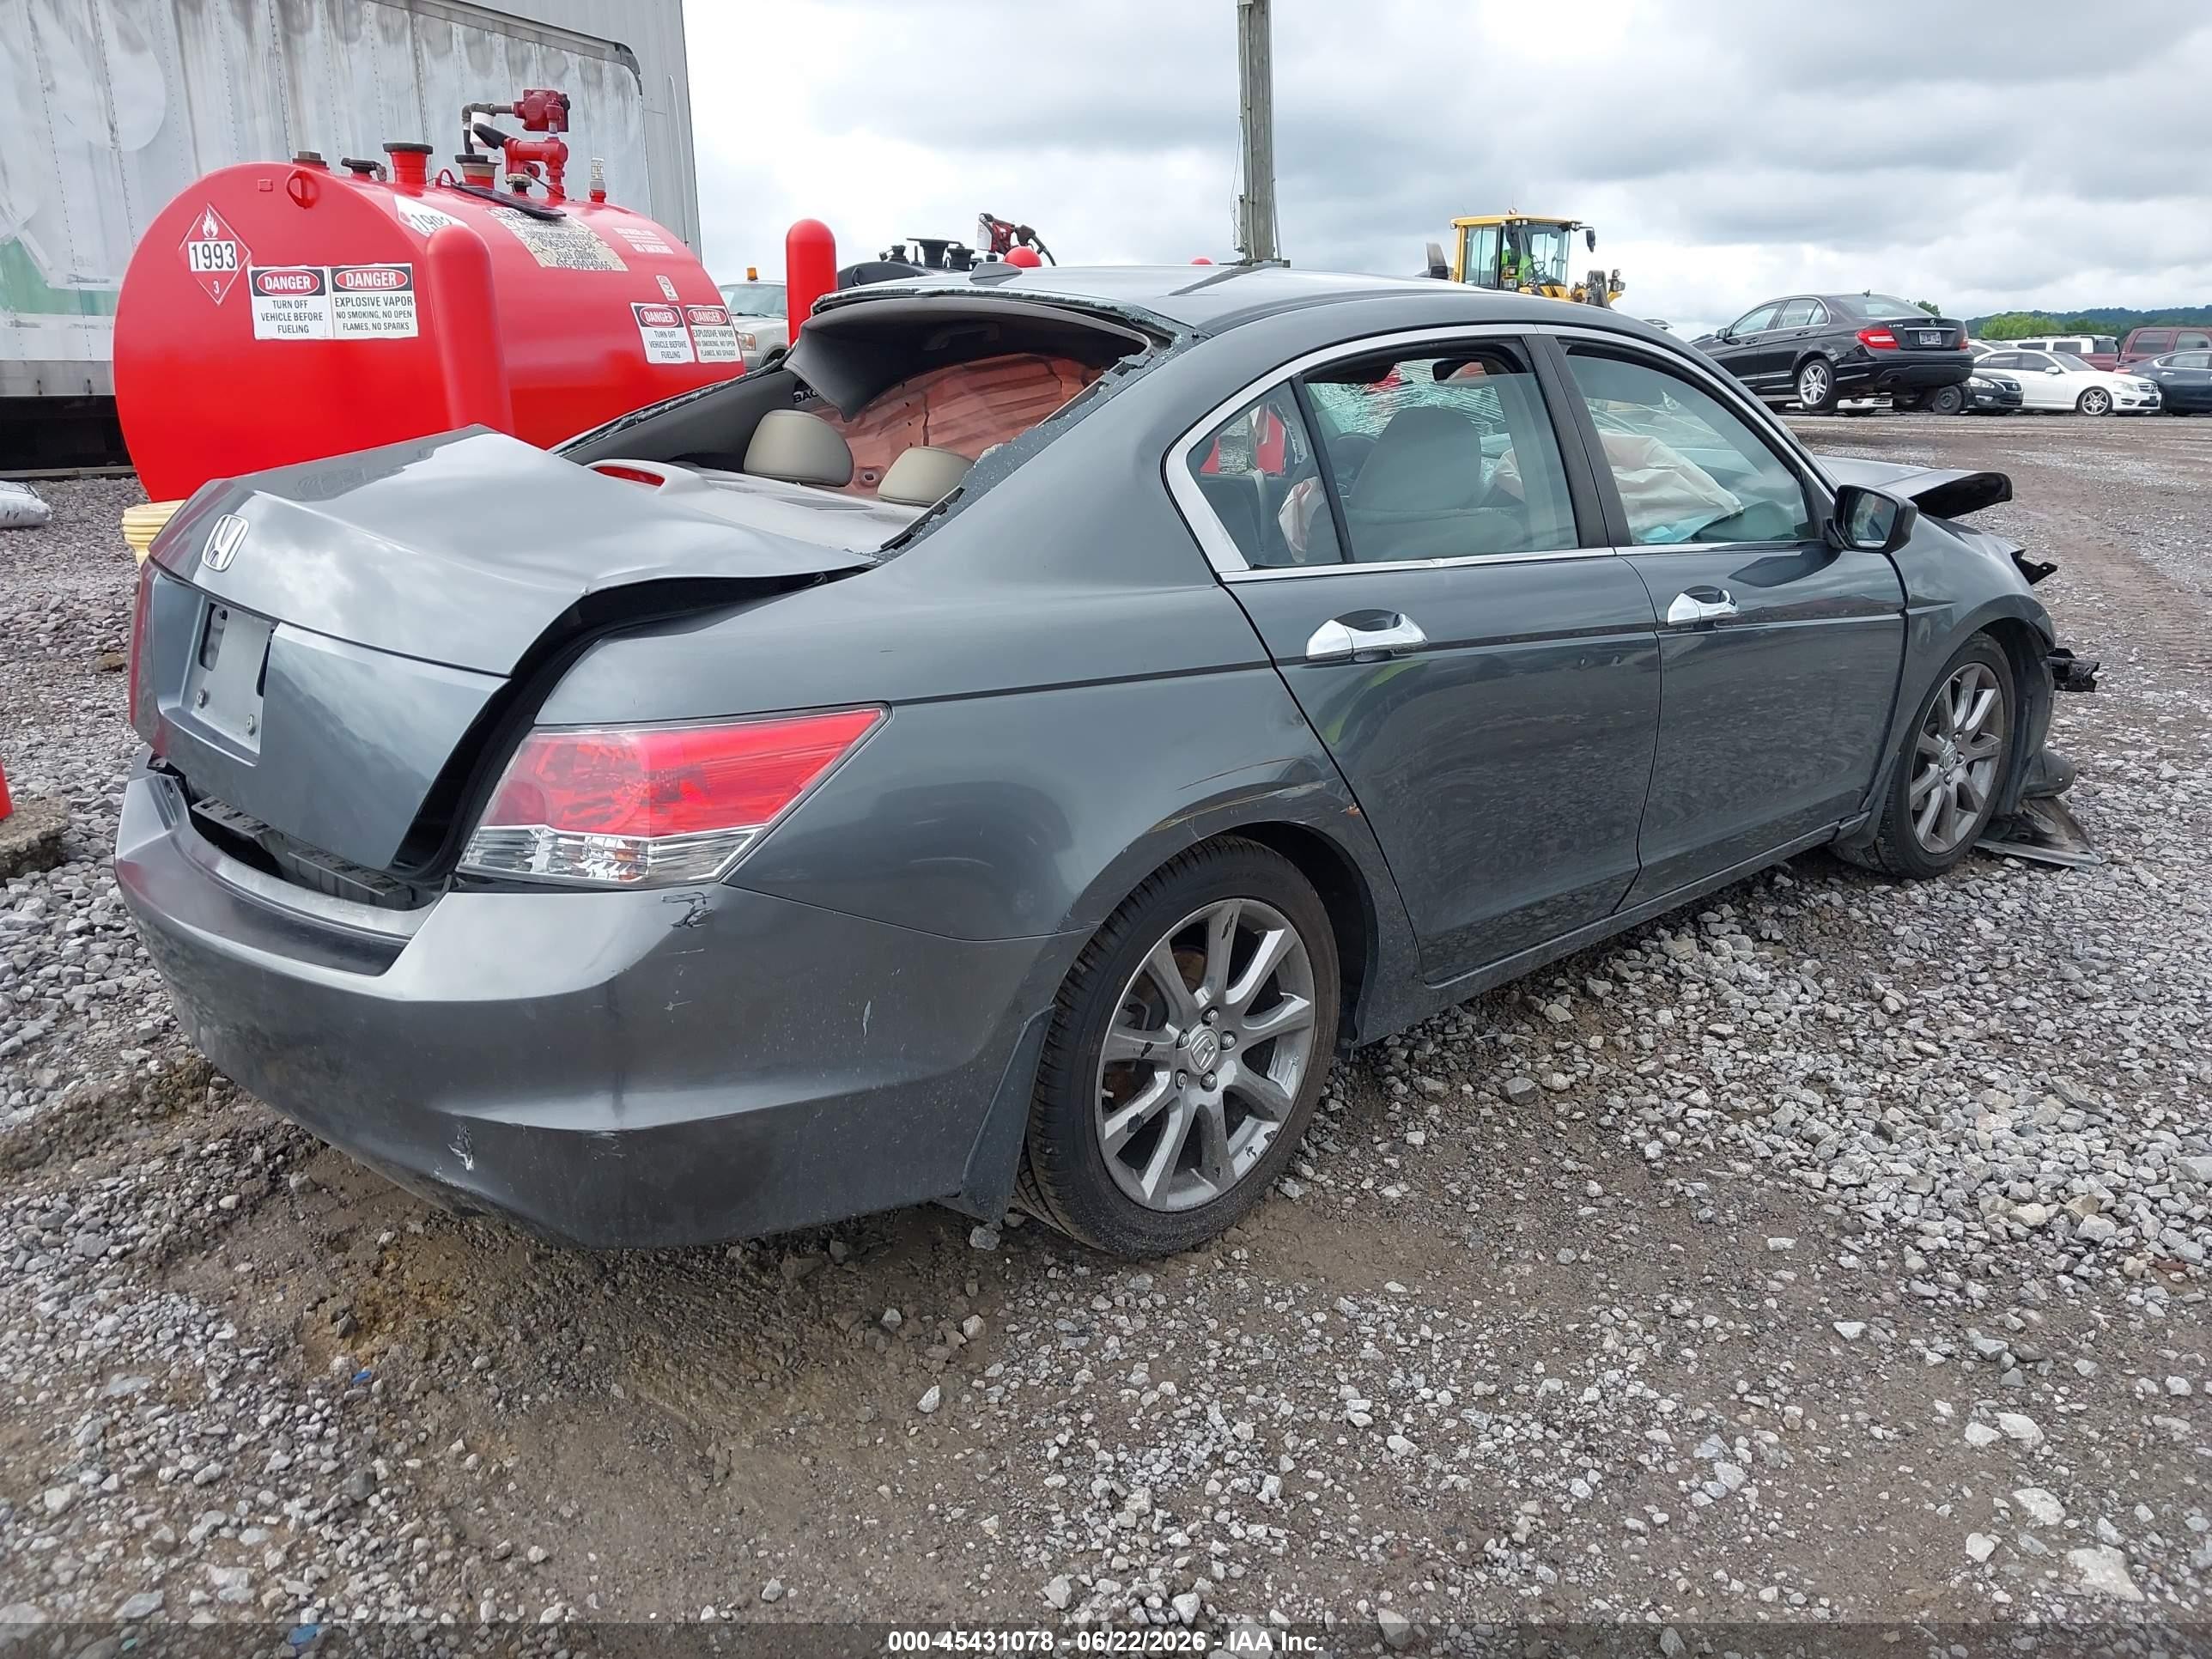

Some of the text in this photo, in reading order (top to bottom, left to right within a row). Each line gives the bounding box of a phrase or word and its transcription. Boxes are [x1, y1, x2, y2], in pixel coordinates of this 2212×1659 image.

[191, 243, 235, 270] 1993
[264, 275, 312, 290] DANGER
[345, 271, 397, 288] DANGER
[213, 280, 220, 294] 3
[272, 300, 308, 309] TURN OFF
[335, 295, 413, 307] EXPLOSIVE VAPOR
[260, 312, 324, 322] VEHICLE BEFORE
[347, 310, 381, 319] SMOKING,
[382, 310, 392, 319] NO
[393, 310, 412, 319] OPEN
[643, 311, 676, 323] DANGER
[692, 311, 722, 323] DANGER
[277, 324, 309, 334] FUELING
[343, 322, 410, 331] FLAMES, NO SPARKS
[648, 340, 688, 349] VEHICLE BEFORE
[660, 350, 681, 359] FUELING
